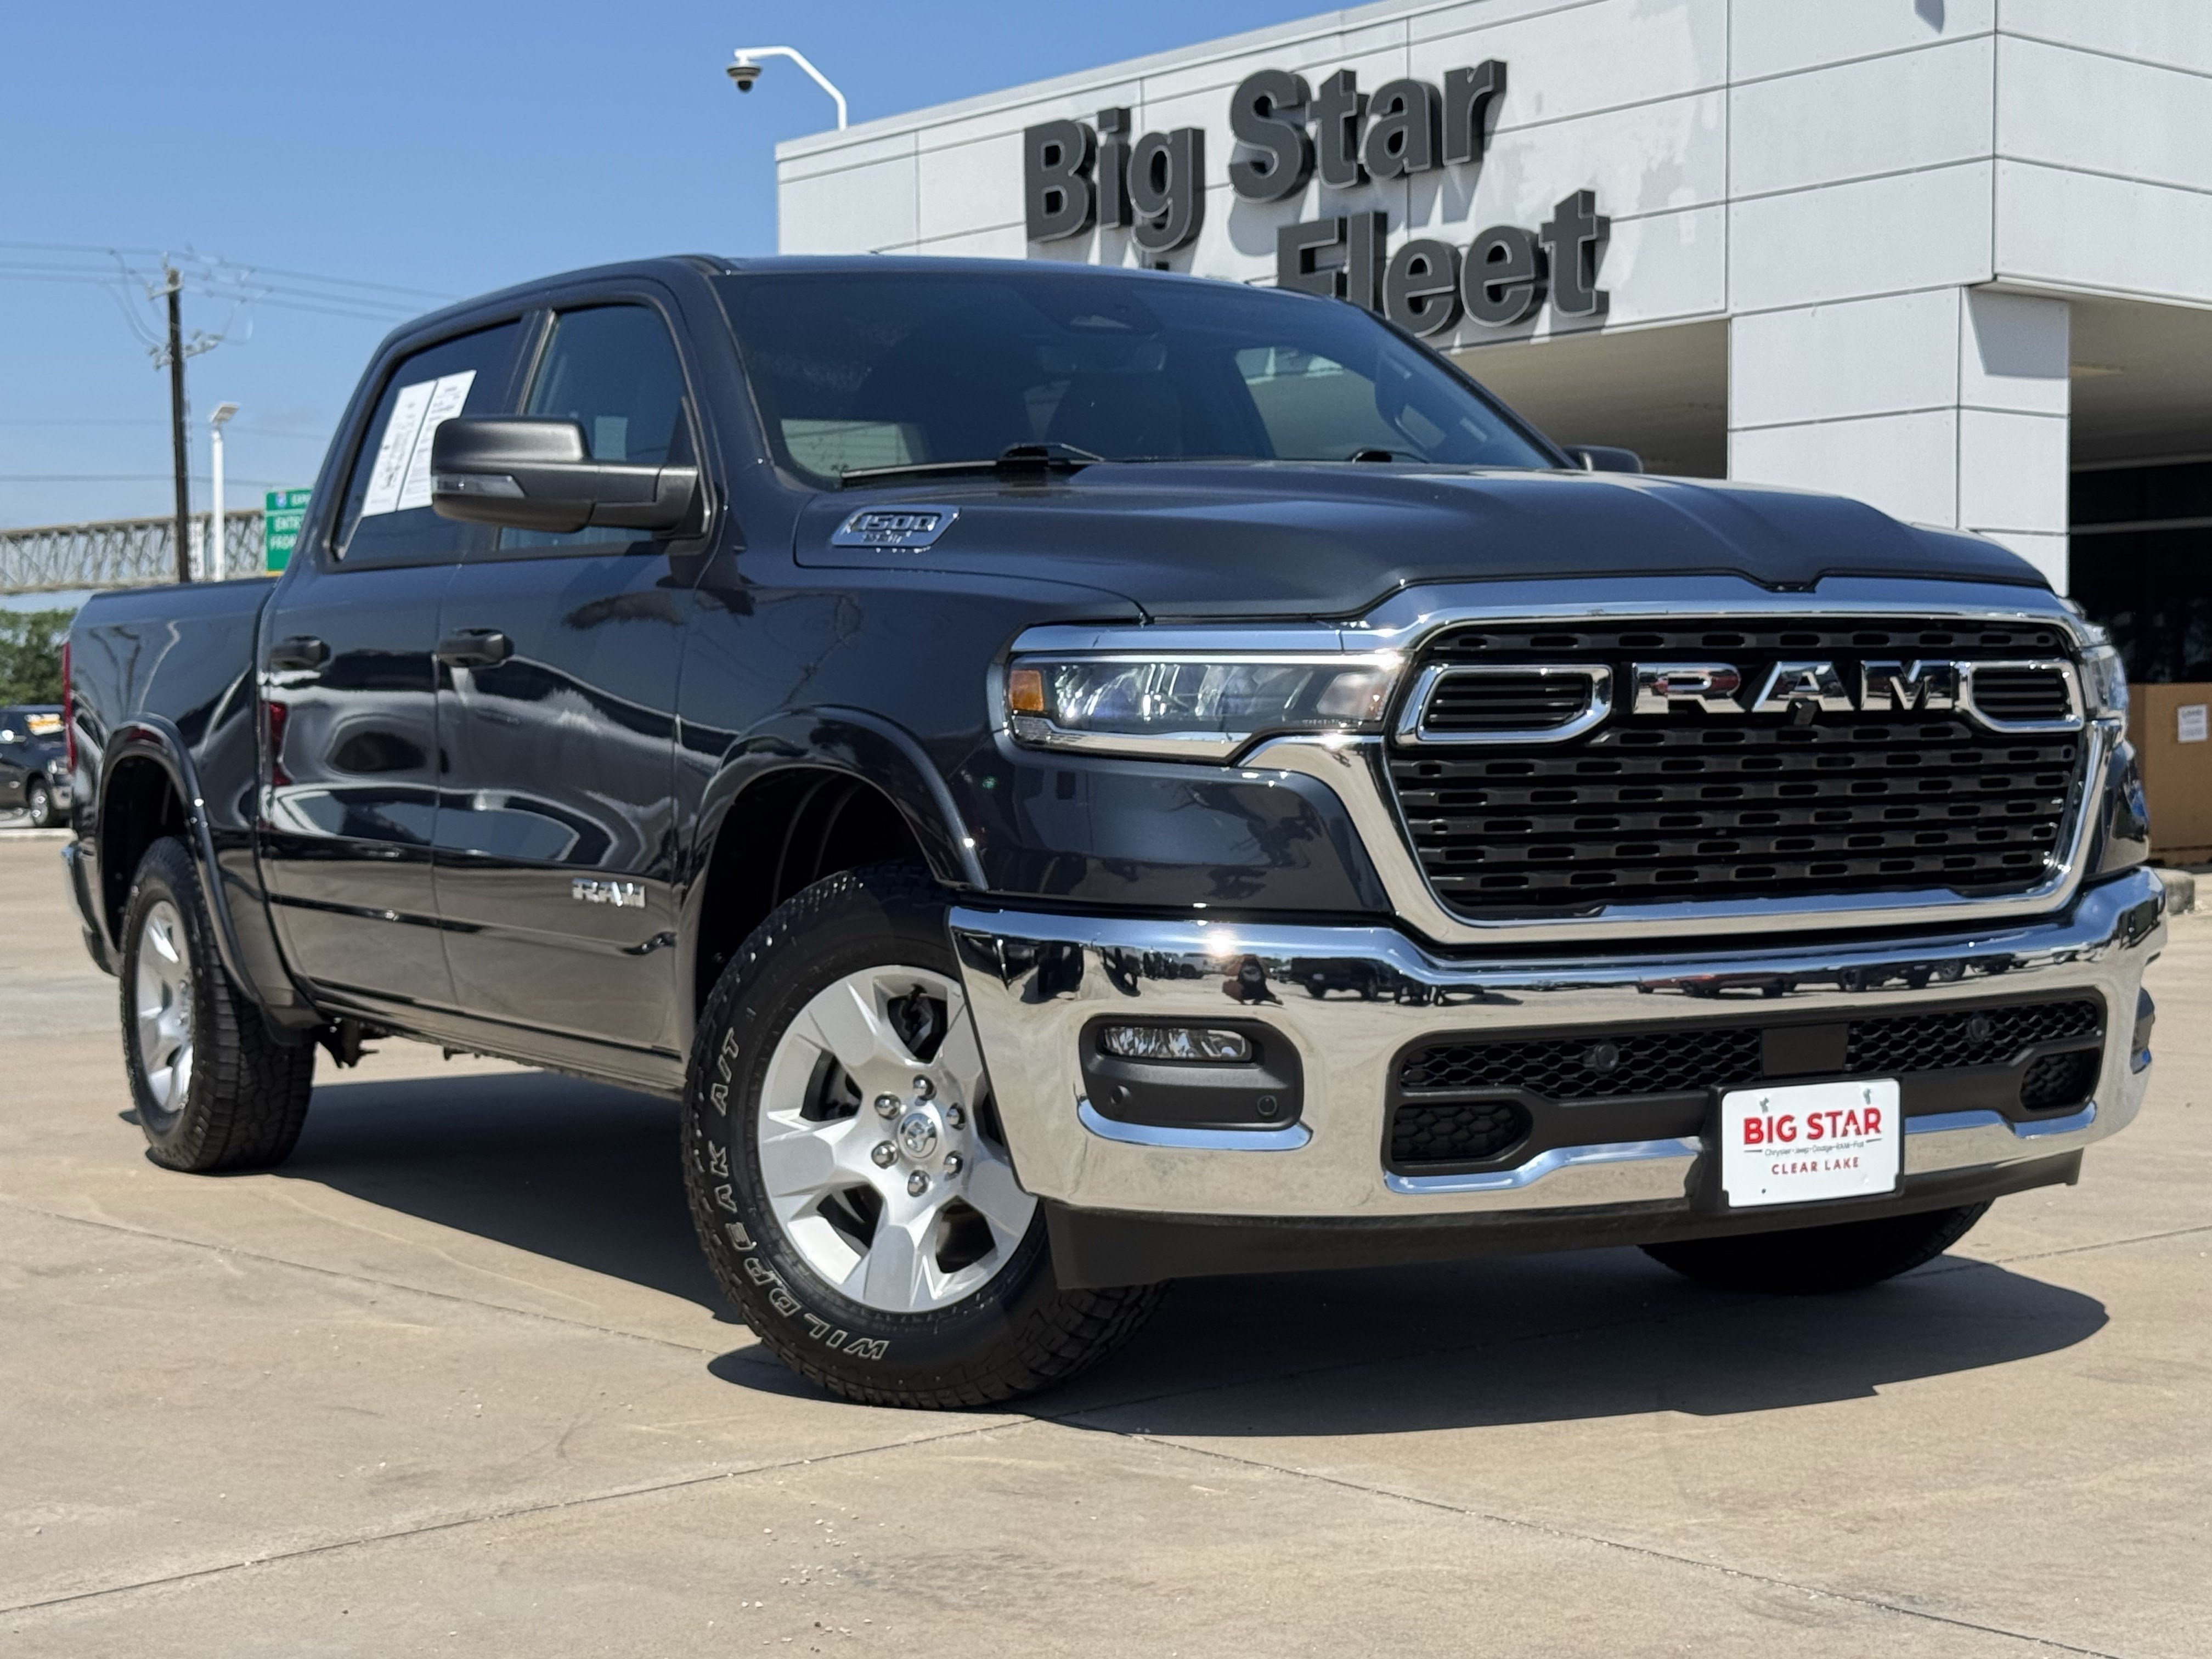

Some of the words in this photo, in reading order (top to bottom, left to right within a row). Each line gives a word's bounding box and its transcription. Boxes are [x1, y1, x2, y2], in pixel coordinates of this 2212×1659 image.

[1024, 107, 1204, 253] Big
[1228, 59, 1508, 203] Star
[1277, 189, 1610, 338] Fleet
[1632, 659, 1954, 714] RAM
[572, 878, 645, 908] RAM
[1743, 1114, 1797, 1145] BIG
[1806, 1107, 1882, 1141] STAR
[1771, 1161, 1818, 1175] CLEAR
[1824, 1156, 1860, 1171] LAKE
[709, 1140, 890, 1361] WILDPEAK
